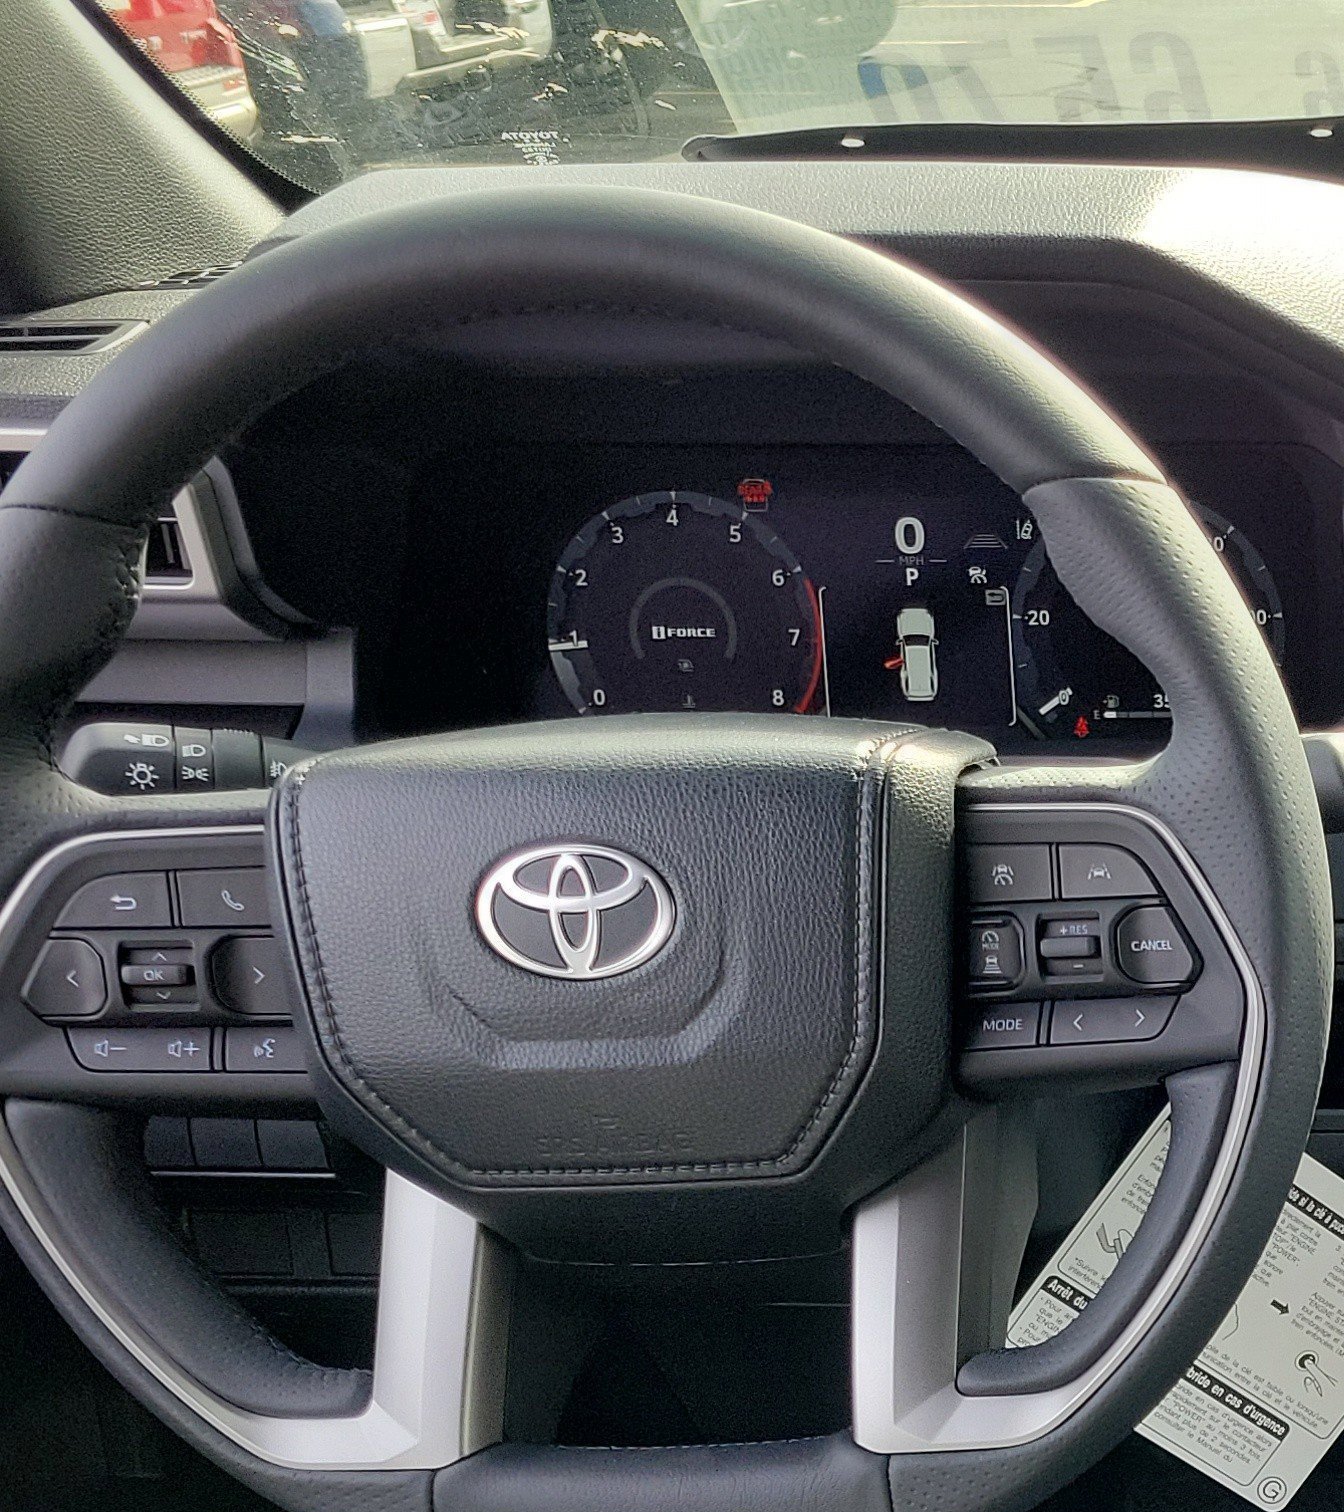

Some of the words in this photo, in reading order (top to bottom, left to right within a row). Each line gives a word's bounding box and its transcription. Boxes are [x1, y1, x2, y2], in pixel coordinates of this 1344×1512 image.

[666, 509, 680, 526] 4
[611, 527, 624, 544] 3
[730, 525, 742, 543] 5
[894, 516, 926, 555] 0
[900, 555, 925, 567] MPH
[575, 570, 588, 587] 2
[772, 569, 785, 587] 6
[906, 568, 919, 586] P
[1028, 609, 1050, 626] 20
[788, 629, 801, 646] 7
[593, 689, 606, 706] 0
[772, 689, 785, 706] 8
[1130, 939, 1173, 952] CANCEL
[143, 969, 166, 982] OK
[983, 1019, 1024, 1031] MODE
[1046, 1277, 1074, 1300] Arrêt
[1072, 1293, 1089, 1310] du
[1185, 1365, 1212, 1389] bride
[1210, 1383, 1225, 1397] en
[1224, 1391, 1243, 1409] cas
[1241, 1401, 1286, 1438] d'urgence
